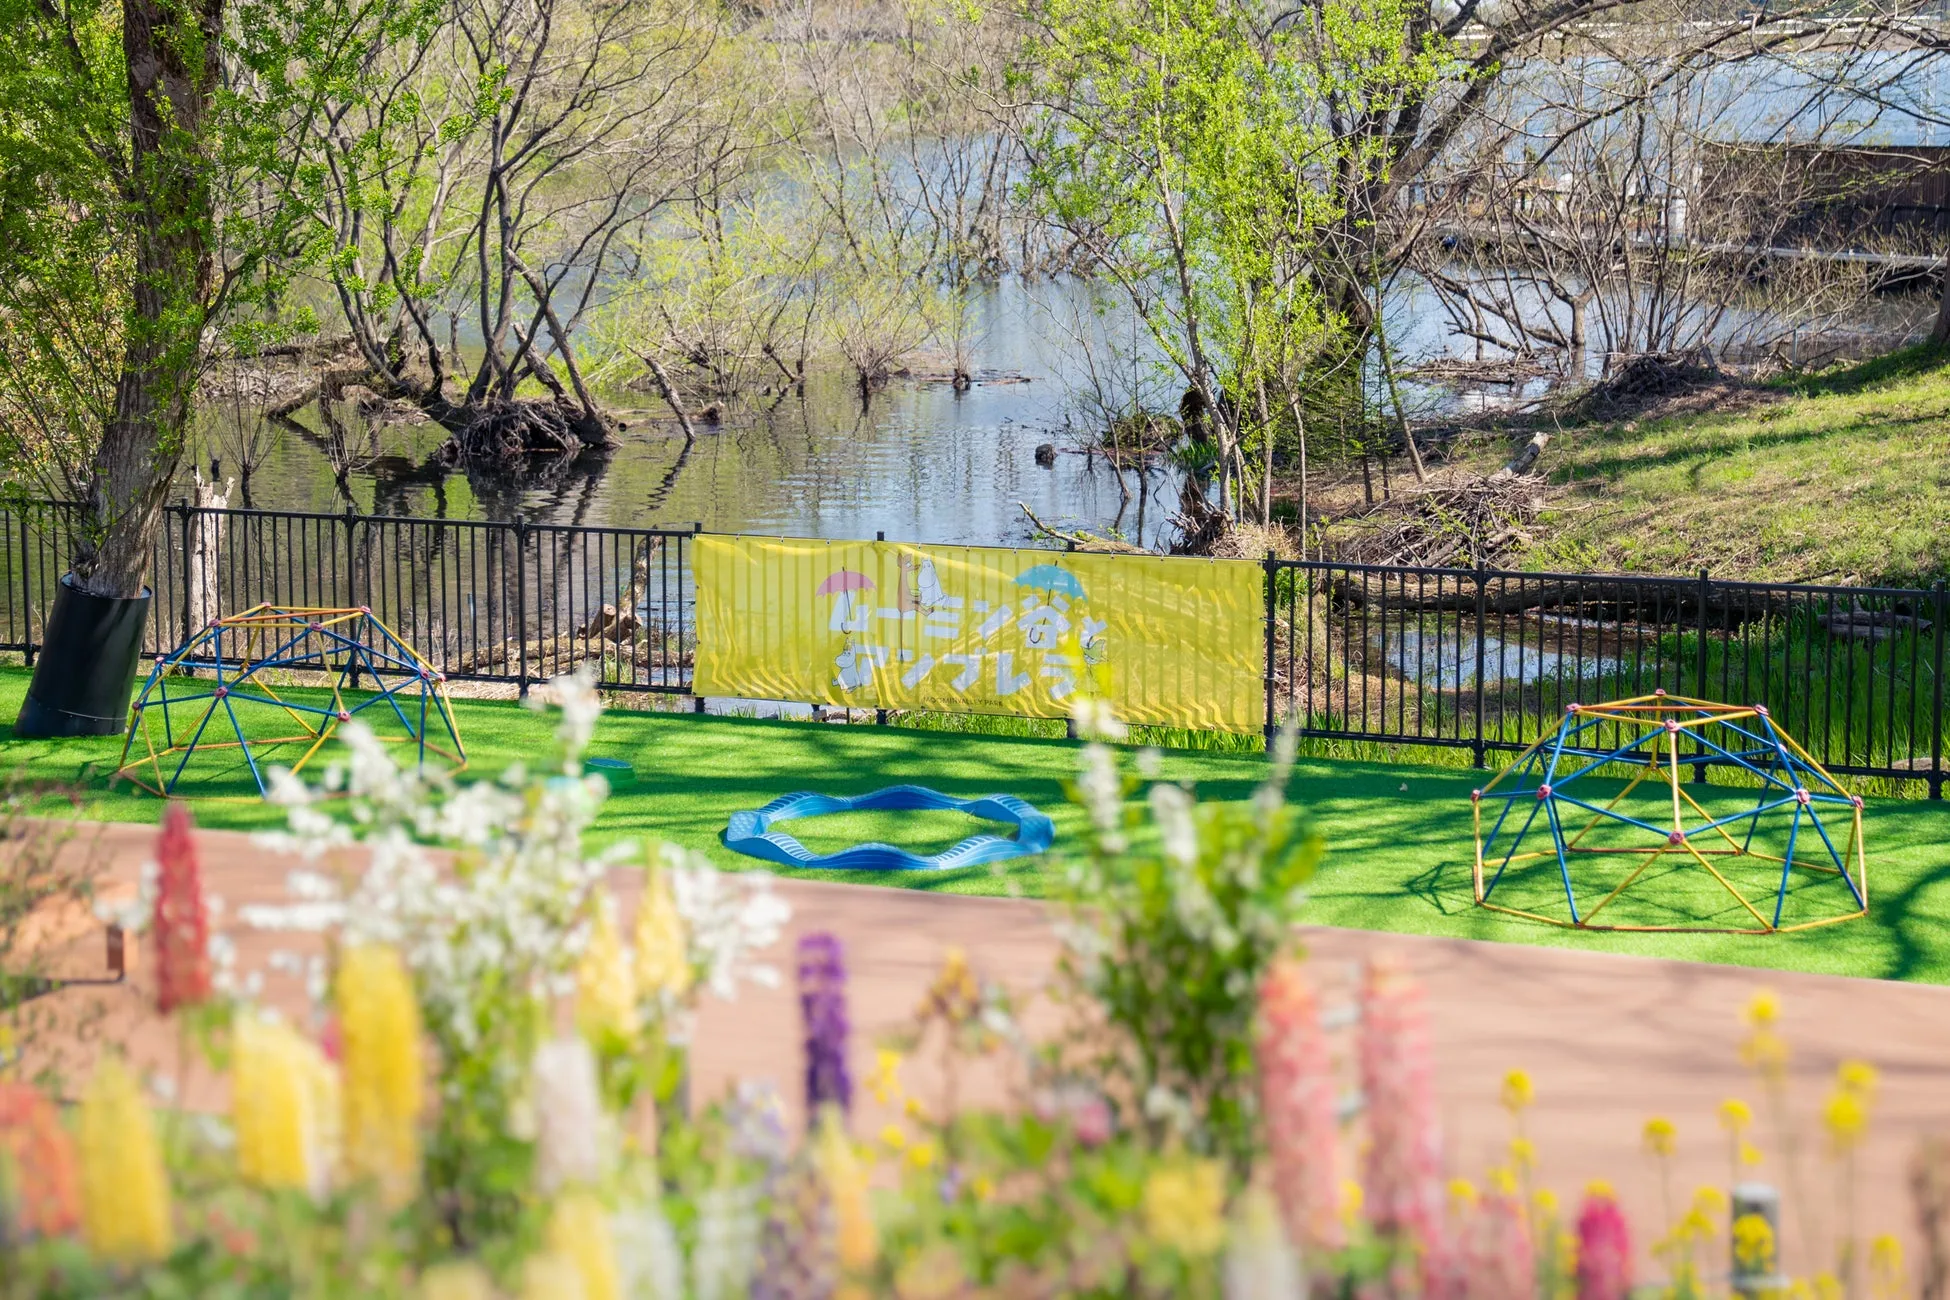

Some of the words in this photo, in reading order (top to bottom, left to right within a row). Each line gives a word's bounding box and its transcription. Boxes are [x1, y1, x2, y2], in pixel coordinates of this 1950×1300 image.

[854, 644, 1080, 700] アンブレラ
[984, 699, 1003, 707] PARK
